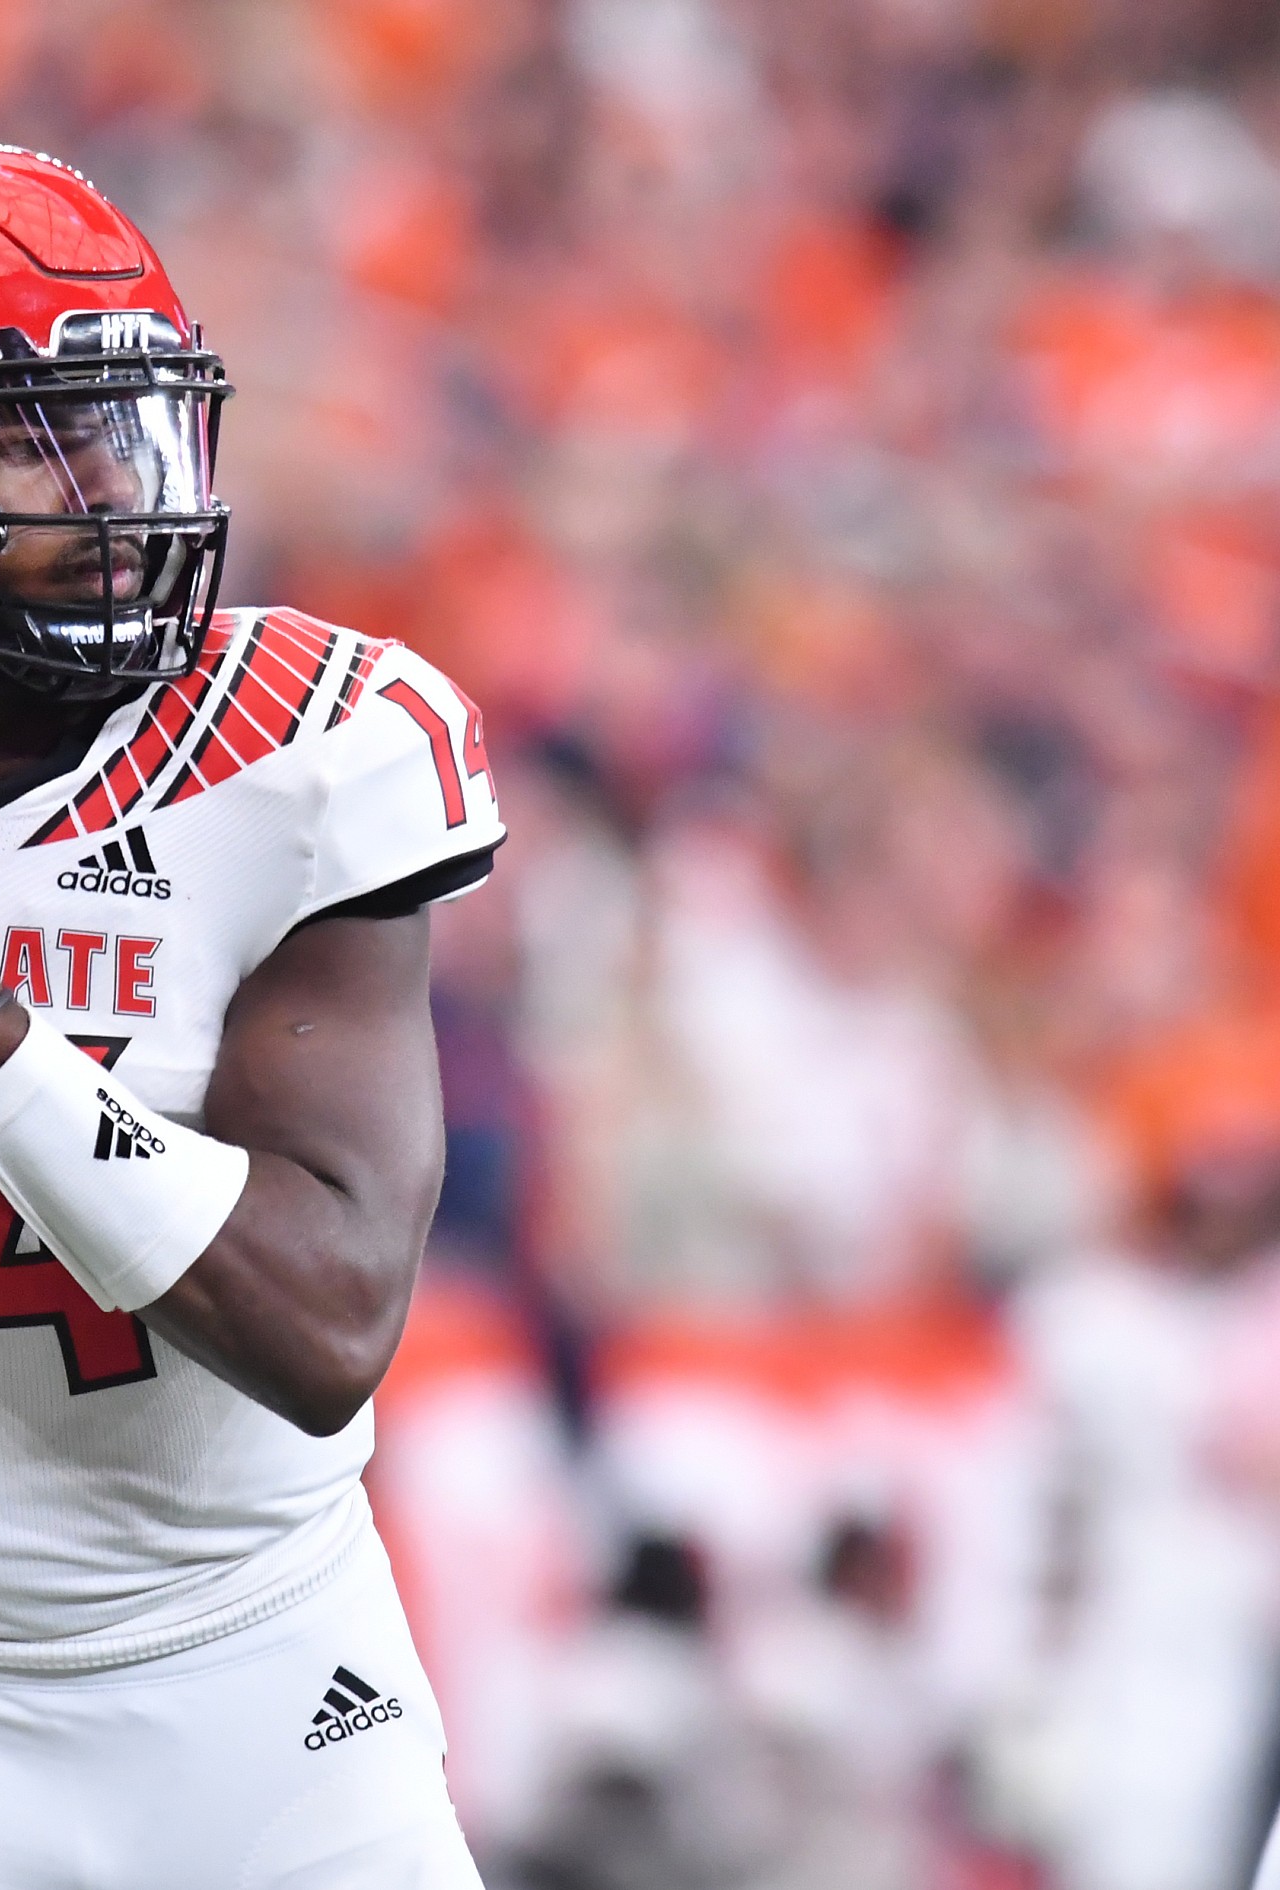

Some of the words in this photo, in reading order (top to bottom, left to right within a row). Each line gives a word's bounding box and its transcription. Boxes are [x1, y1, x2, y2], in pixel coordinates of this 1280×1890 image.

[101, 314, 151, 349] HTT
[375, 678, 497, 832] 14
[56, 867, 172, 901] adidas
[95, 1087, 166, 1154] adidas
[304, 1697, 403, 1751] adidas
